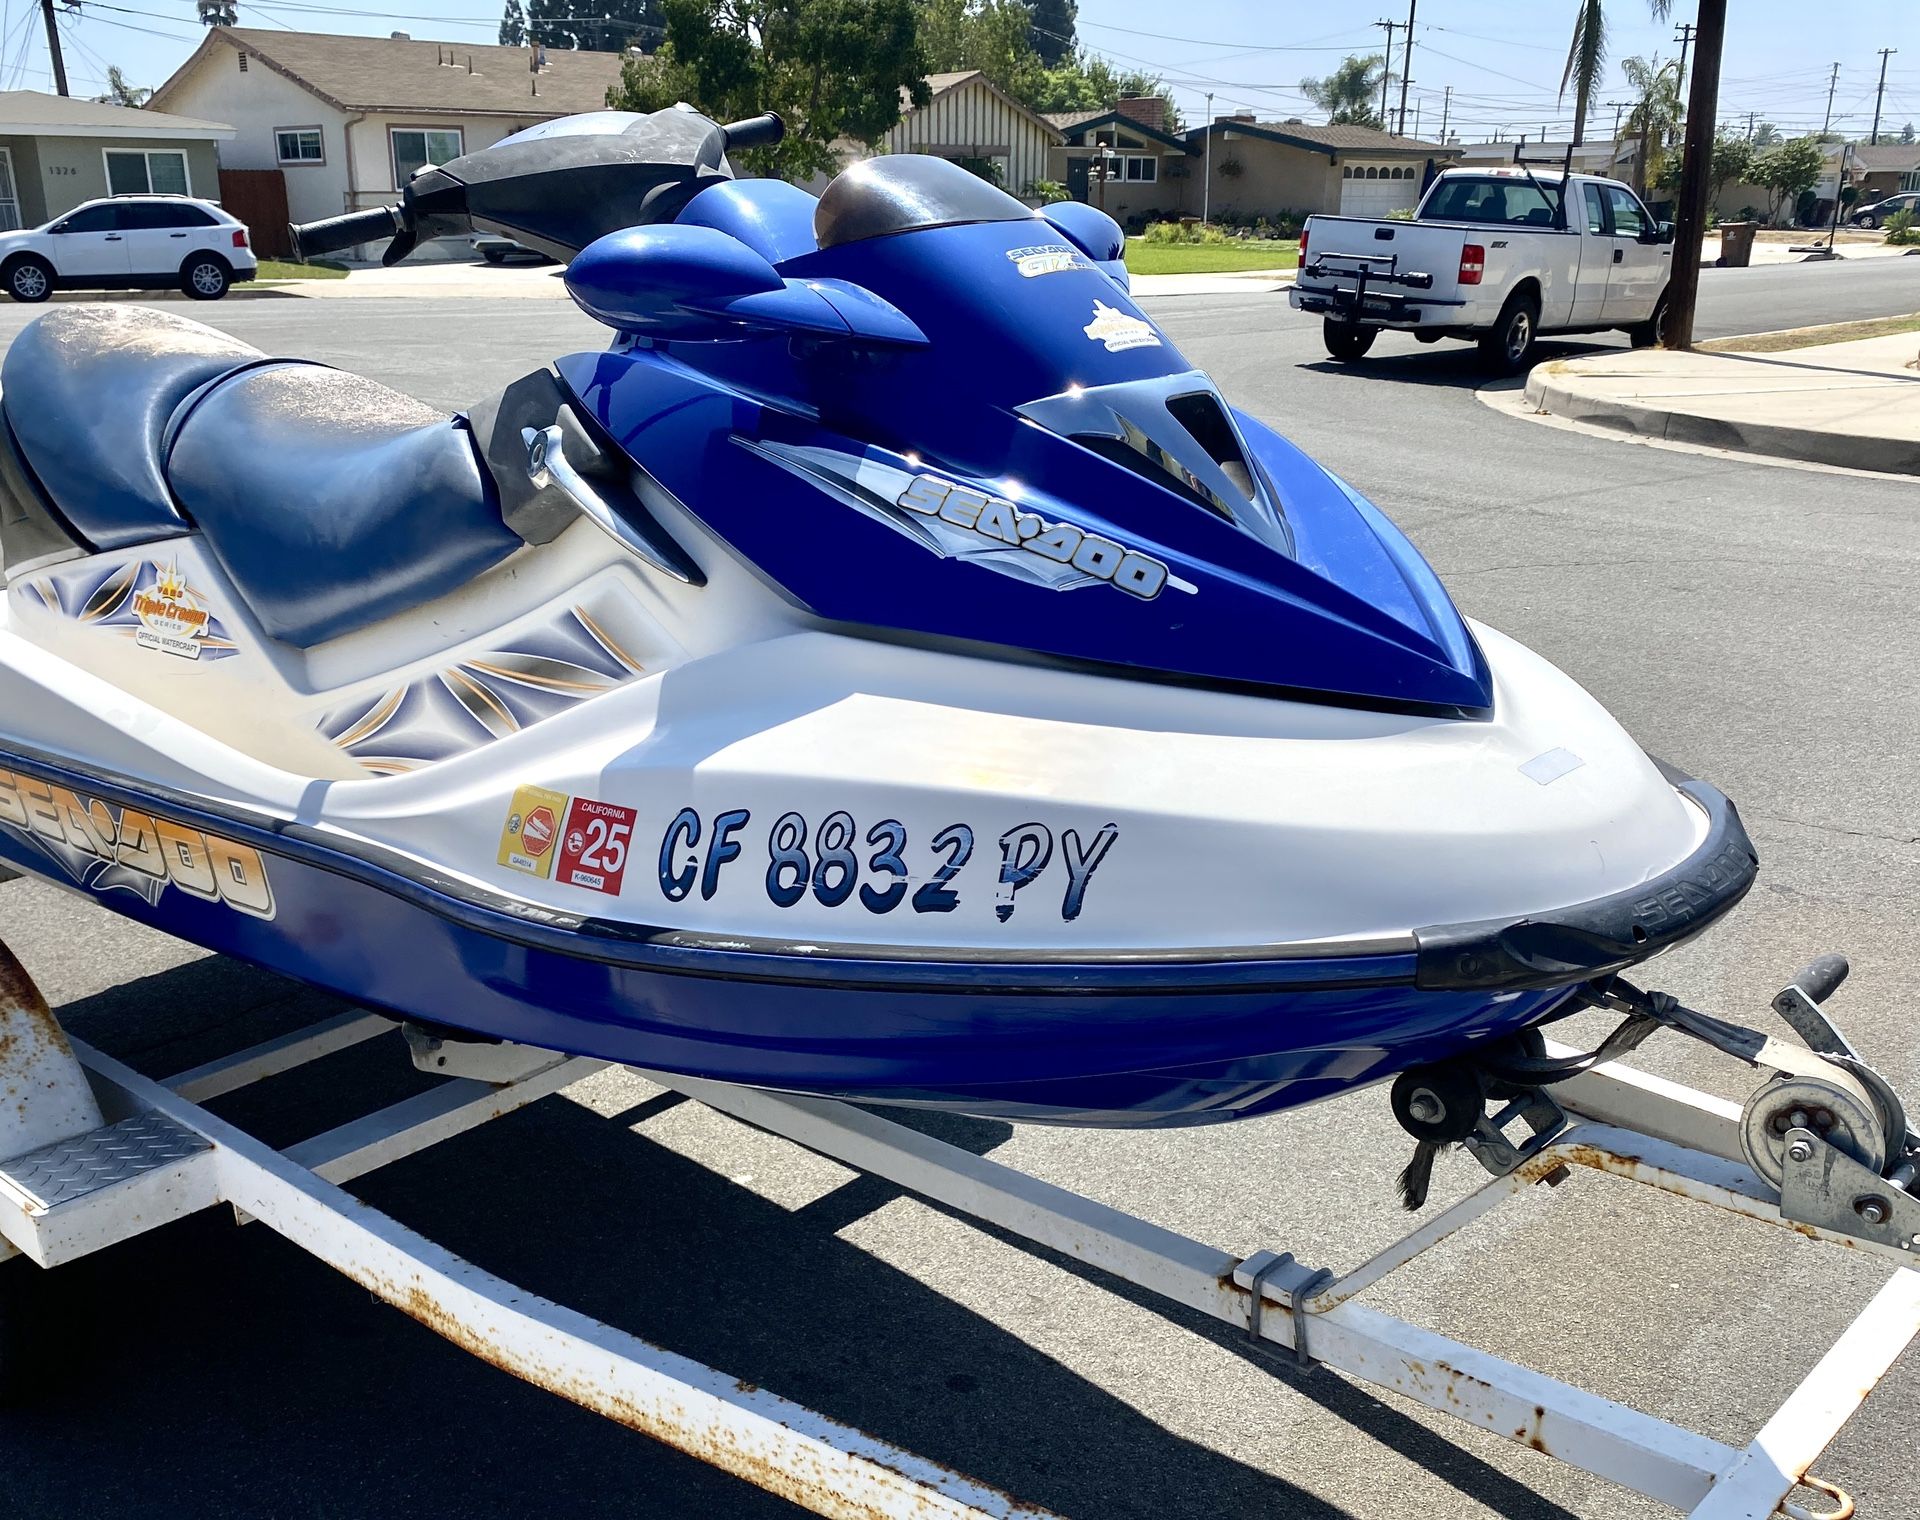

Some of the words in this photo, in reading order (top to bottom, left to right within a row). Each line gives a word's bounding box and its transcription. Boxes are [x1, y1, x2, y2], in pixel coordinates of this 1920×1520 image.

[134, 594, 167, 616] Triple
[166, 602, 207, 626] Crown
[138, 631, 161, 644] OFFICIAL
[161, 637, 198, 653] WATERCRAFT
[581, 802, 626, 820] CALIFORNIA
[579, 818, 630, 873] 25
[659, 807, 750, 902] CF
[765, 810, 975, 915] 8832
[996, 822, 1119, 923] PY
